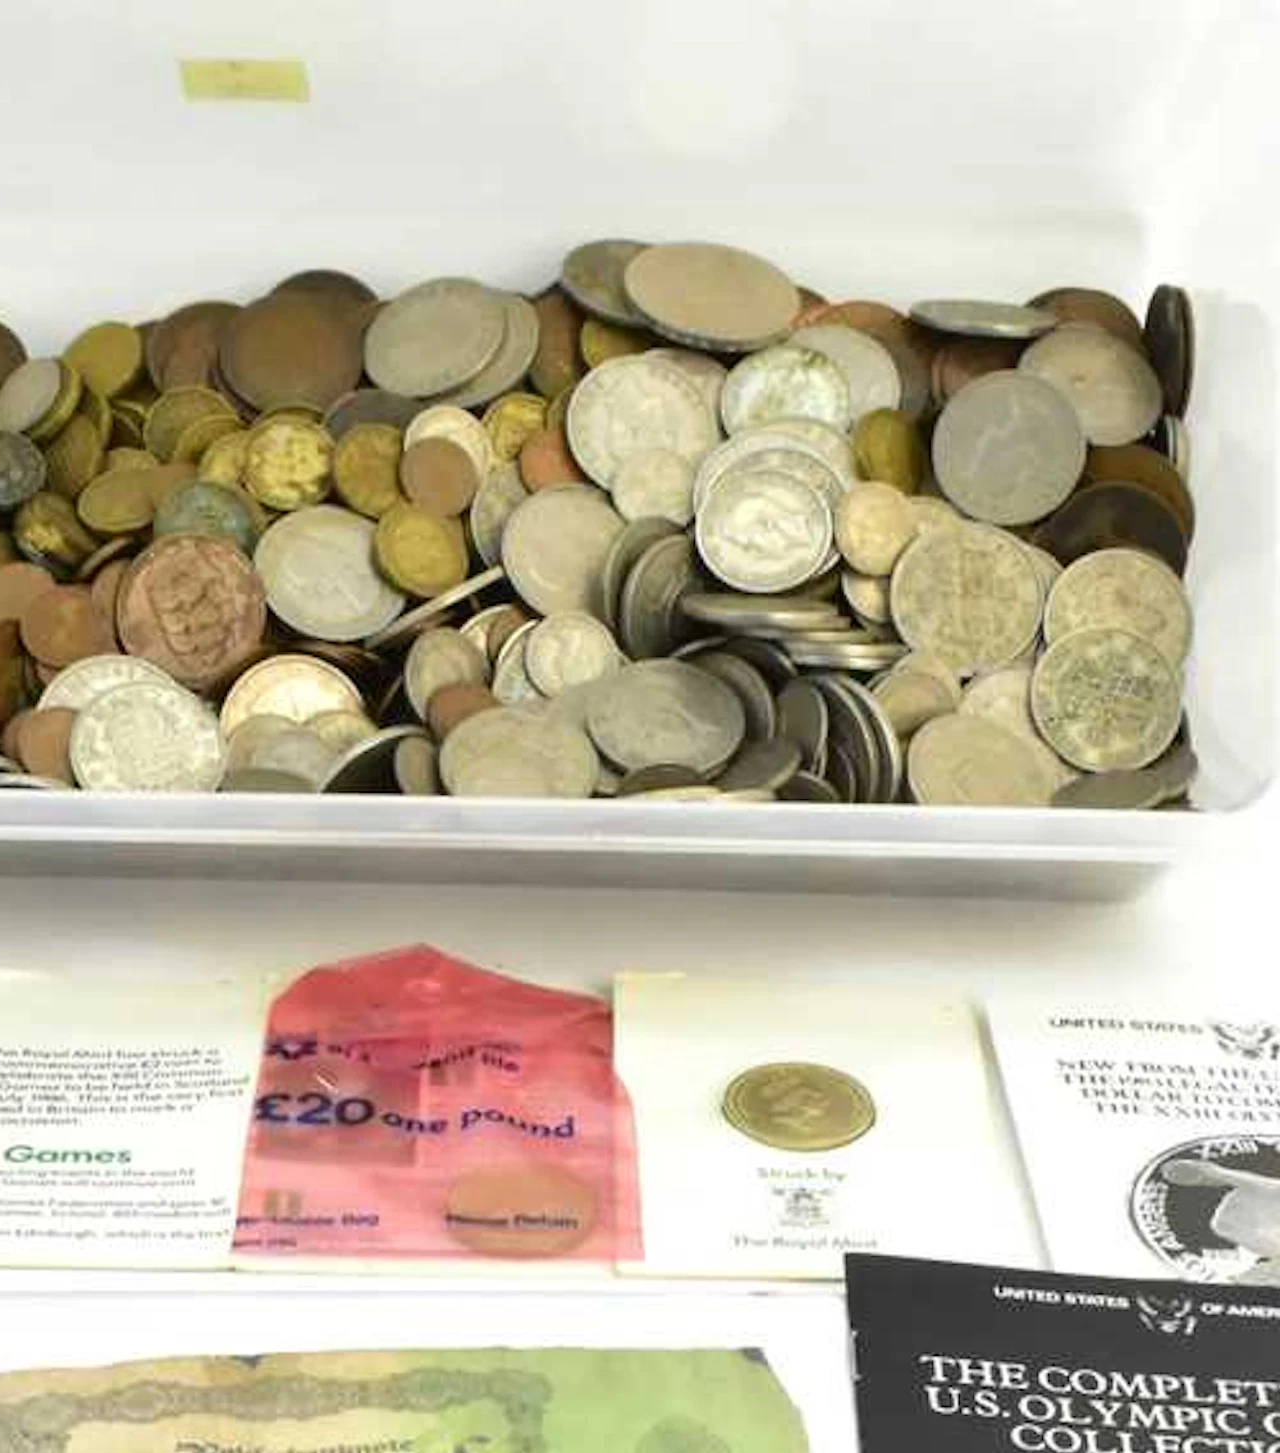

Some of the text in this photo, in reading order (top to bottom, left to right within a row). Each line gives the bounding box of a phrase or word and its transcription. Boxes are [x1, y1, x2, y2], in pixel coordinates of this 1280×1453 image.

[256, 1092, 376, 1126] £20
[382, 1113, 449, 1135] one
[460, 1106, 576, 1140] pound
[4, 1145, 133, 1164] Games
[993, 1283, 1062, 1306] UNITED
[1064, 1291, 1131, 1311] STATES
[1200, 1301, 1225, 1318] OF
[920, 1355, 1030, 1391] THE
[924, 1386, 1013, 1418] U.S.
[1018, 1395, 1253, 1437] OLYMPIC
